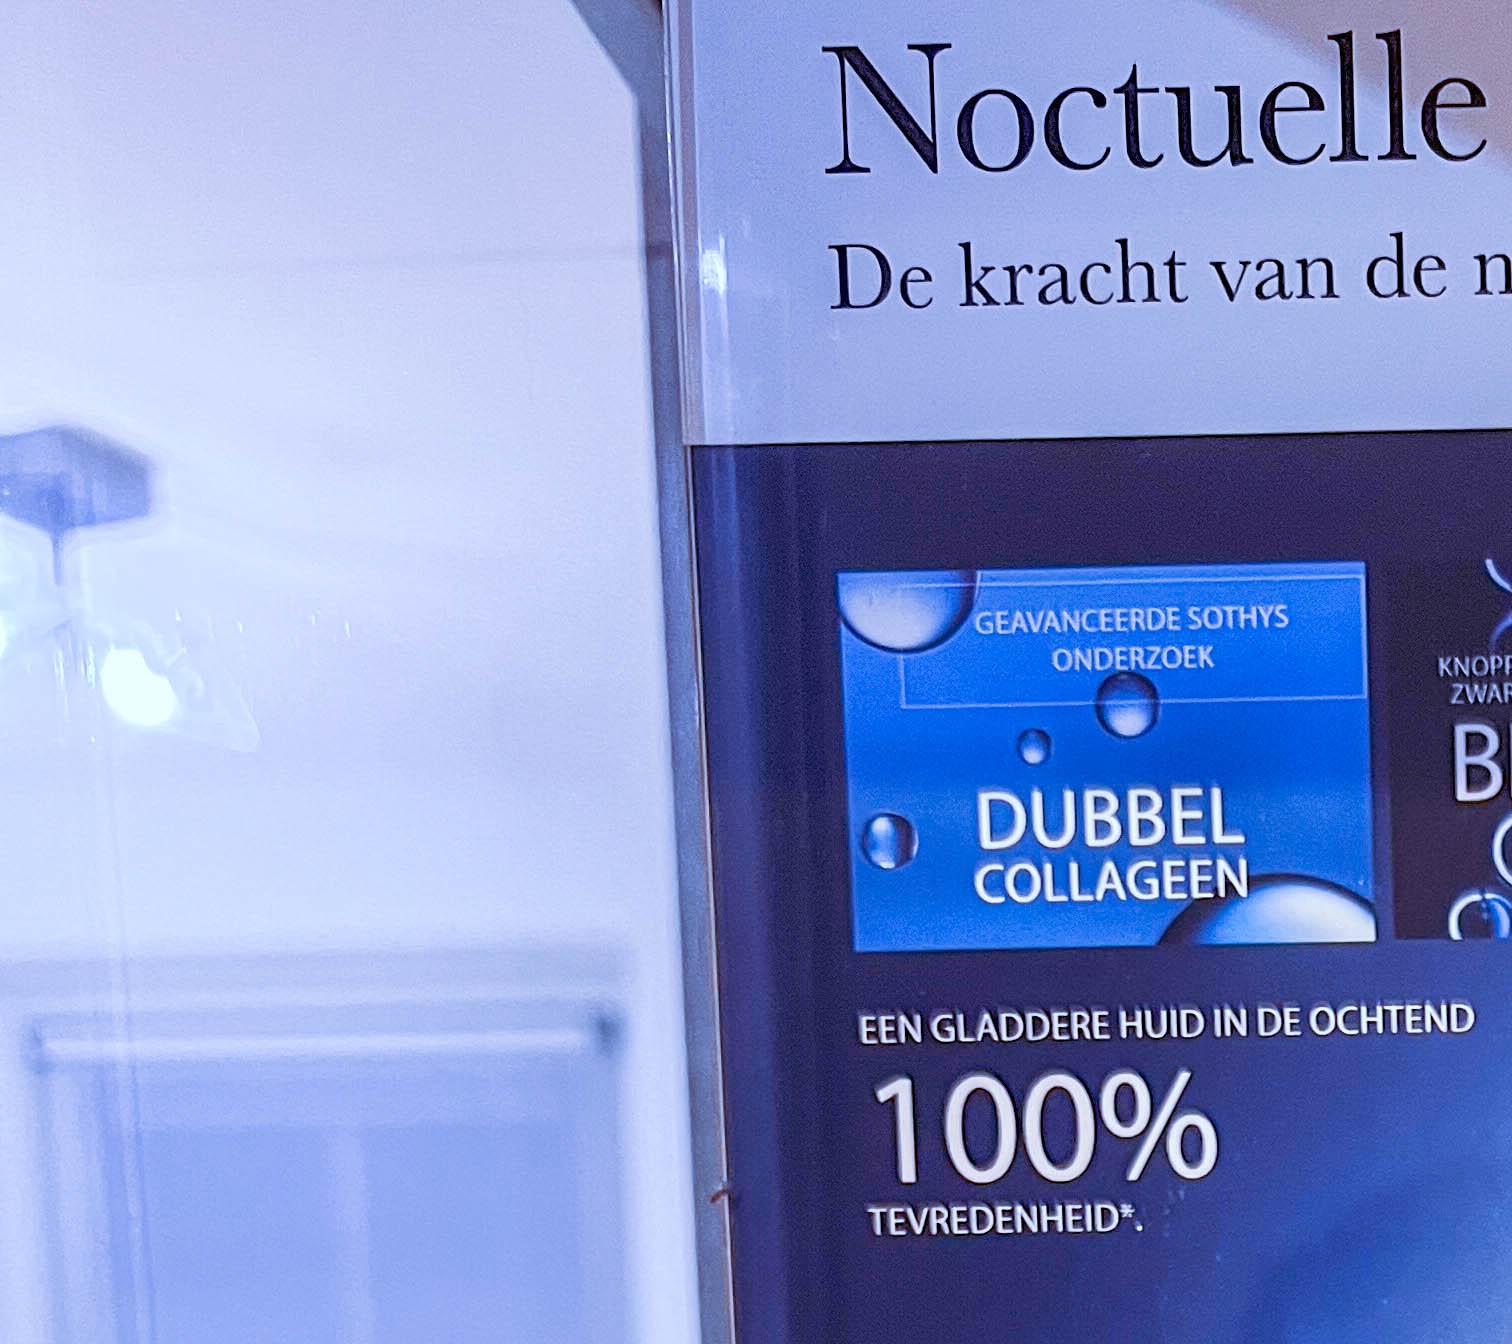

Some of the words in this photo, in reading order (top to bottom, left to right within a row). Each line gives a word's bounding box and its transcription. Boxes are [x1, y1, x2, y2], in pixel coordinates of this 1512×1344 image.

[822, 30, 1490, 177] Noctuelle
[829, 243, 934, 312] De
[957, 241, 1188, 310] kracht
[1209, 246, 1339, 305] van
[1364, 231, 1447, 304] de
[975, 608, 1182, 636] GEAVANCEERDE
[1188, 603, 1288, 631] SOTHYS
[1052, 644, 1214, 673] ONDERZOEK
[977, 785, 1246, 851] DUBBEL
[974, 857, 1249, 904] COLLAGEEN
[859, 1014, 923, 1046] EEN
[930, 1009, 1109, 1044] GLADDERE
[1117, 1007, 1204, 1041] HUID
[1213, 1007, 1249, 1038] IN
[1257, 1006, 1302, 1038] DE
[1309, 1002, 1474, 1037] OCHTEND
[873, 1069, 1218, 1185] 100%
